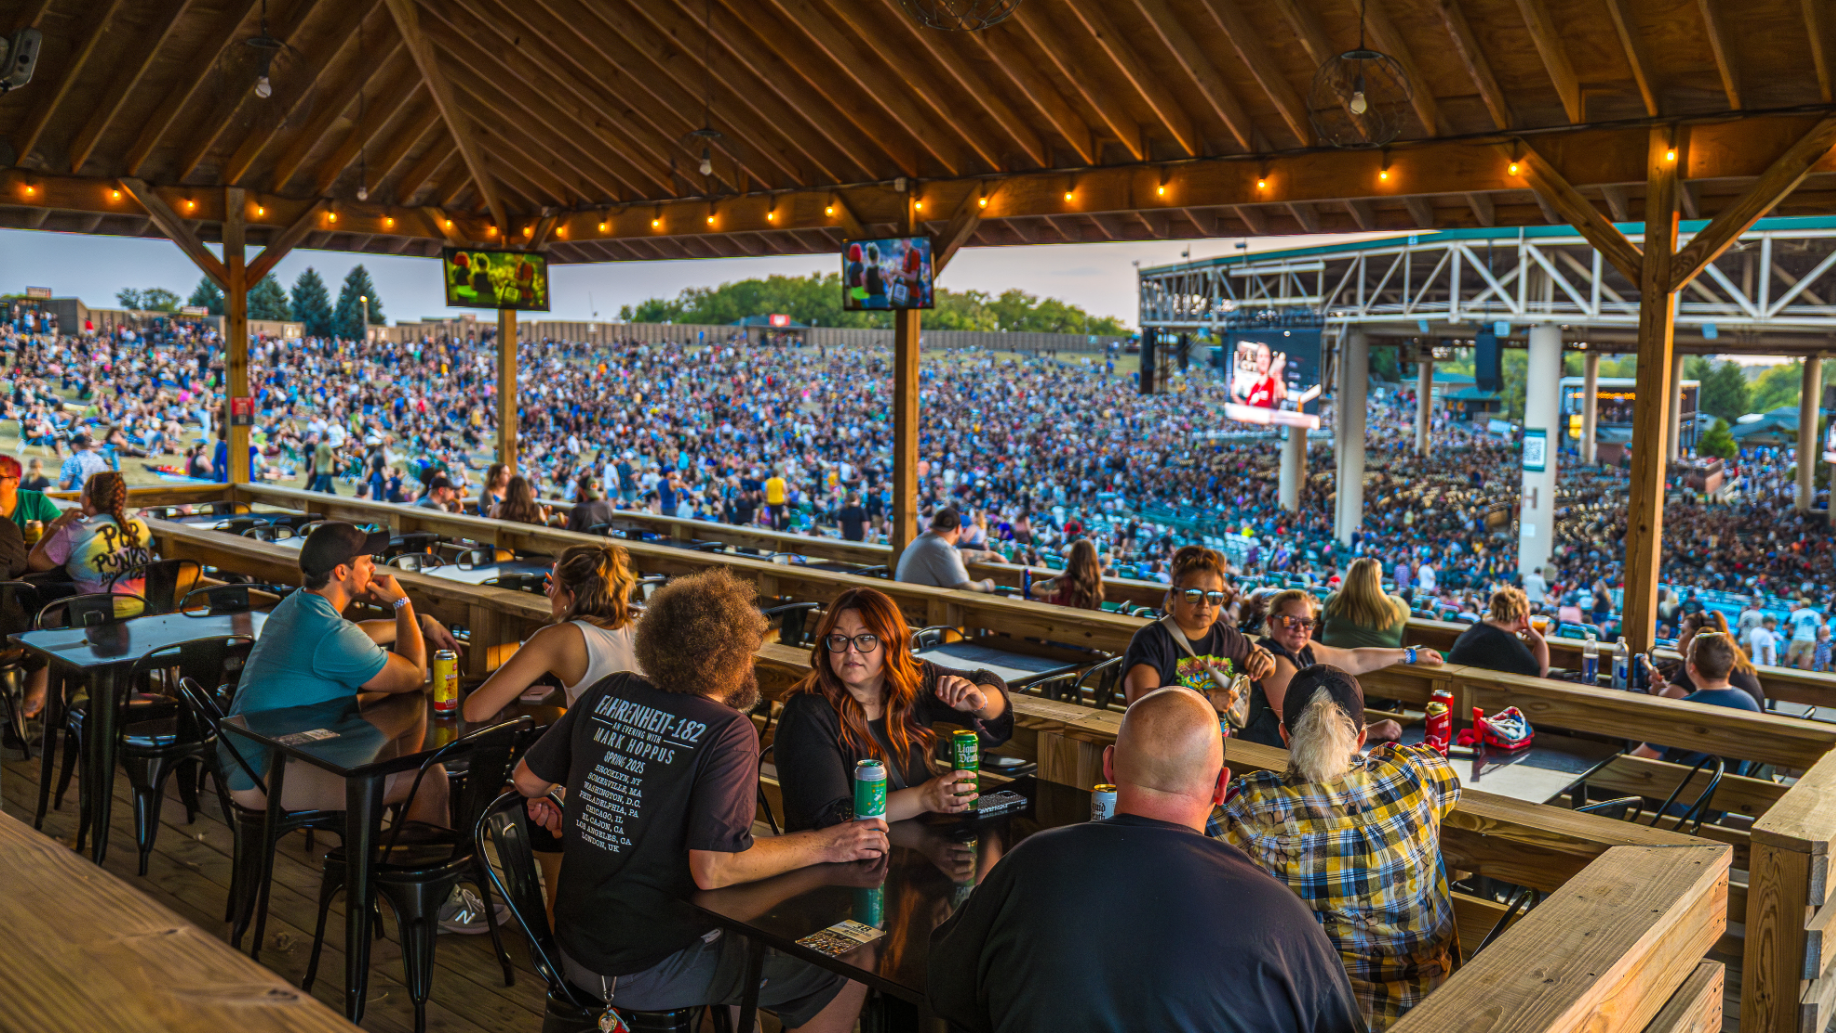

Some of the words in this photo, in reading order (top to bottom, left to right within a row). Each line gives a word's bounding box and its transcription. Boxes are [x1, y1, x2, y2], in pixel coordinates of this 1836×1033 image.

[594, 694, 707, 743] FAHRENHEIT-182
[612, 721, 622, 731] AN
[621, 724, 646, 740] EVENING
[646, 732, 662, 744] WITH
[593, 727, 626, 749] MARK
[626, 738, 675, 764] HOPPUS
[603, 750, 627, 768] SPRING
[625, 758, 646, 774] 2025
[587, 771, 628, 795] SOMERVILLE,
[628, 787, 642, 798] MA
[595, 764, 630, 784] BROOKLYN,
[630, 777, 642, 786] NY
[579, 790, 627, 816] PHILADELPHIA,
[628, 808, 639, 818] PA
[583, 780, 625, 805] WASHINGTON,
[625, 797, 641, 808] D.C.
[582, 812, 589, 822] EL
[589, 816, 612, 832] CAJON,
[613, 825, 624, 835] CA
[585, 804, 614, 823] CHICAGO,
[615, 815, 624, 824] IL
[575, 818, 586, 830] LOS
[586, 825, 619, 844] ANGELES,
[620, 836, 632, 846] CA
[581, 831, 607, 851] LONDON,
[608, 843, 620, 853] UK
